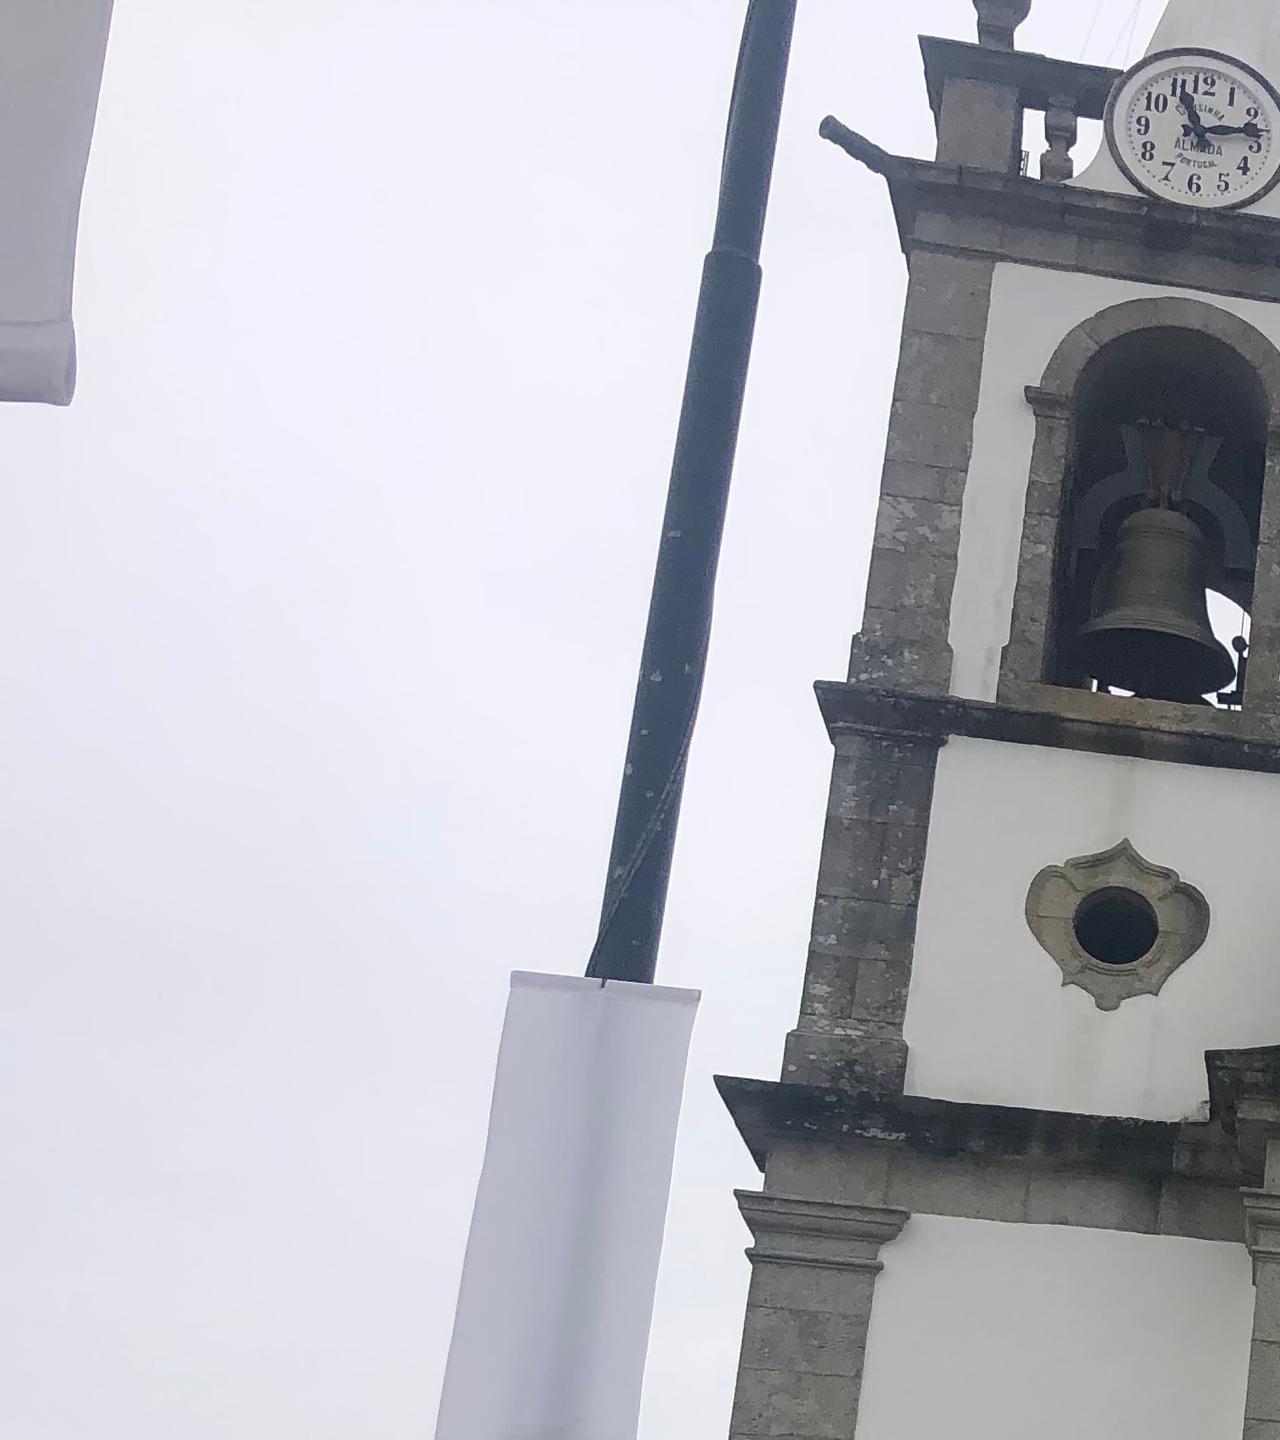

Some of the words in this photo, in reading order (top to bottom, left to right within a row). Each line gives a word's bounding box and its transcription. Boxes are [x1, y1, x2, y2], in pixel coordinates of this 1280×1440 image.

[1170, 77, 1187, 99] 11
[1193, 74, 1216, 97] 12
[1145, 91, 1168, 113] 10
[1228, 87, 1236, 107] 1
[1175, 104, 1225, 122] CSINHA
[1136, 115, 1150, 136] 9
[1141, 140, 1156, 162] 8
[1174, 136, 1223, 157] ALMDA
[1175, 152, 1218, 169] PORTUGAL
[1236, 155, 1251, 176] 4
[1161, 161, 1176, 182] 7
[1216, 172, 1230, 192] 5
[1187, 173, 1202, 194] 6
